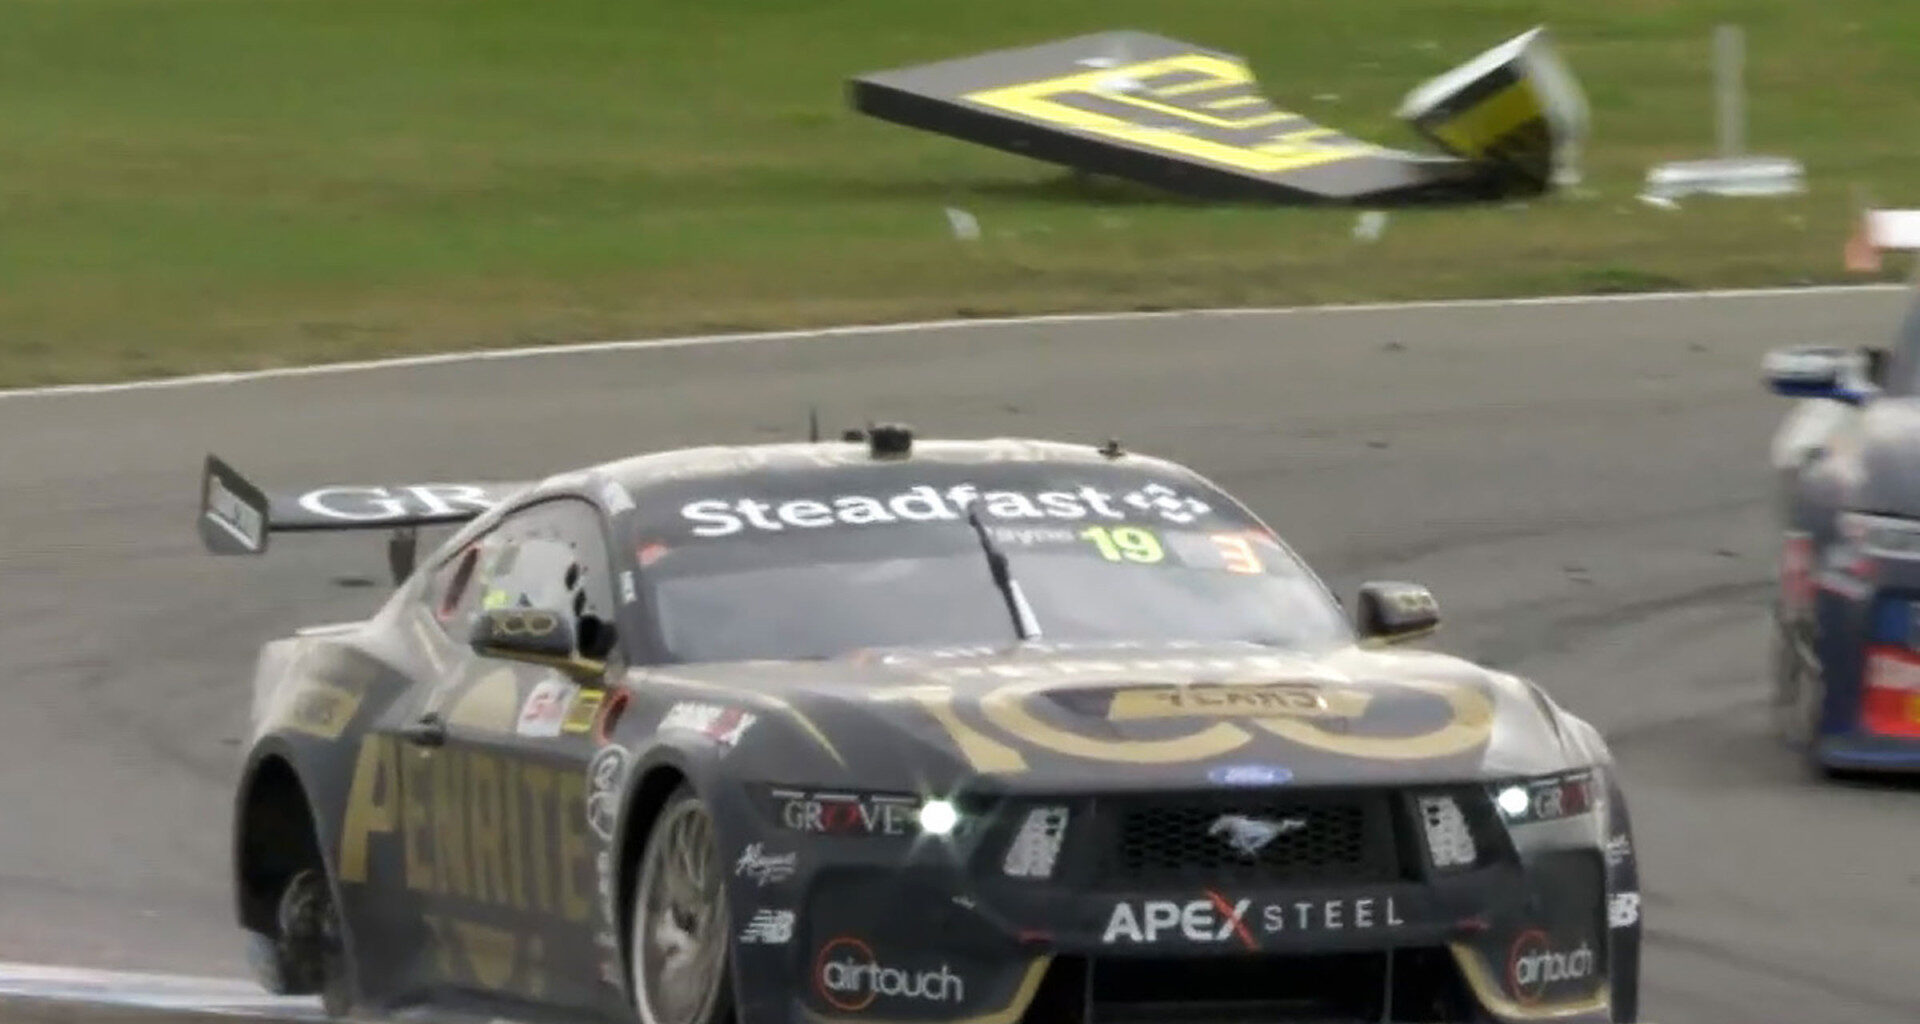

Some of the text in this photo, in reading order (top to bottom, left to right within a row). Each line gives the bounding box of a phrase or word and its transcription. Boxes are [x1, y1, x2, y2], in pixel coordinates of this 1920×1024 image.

[680, 484, 1126, 537] Steadfast
[1080, 526, 1164, 562] 19
[340, 732, 596, 922] PENRITE
[1103, 890, 1405, 951] APEX STEEL
[822, 957, 964, 1003] airtouch
[1513, 942, 1595, 985] airtouch
